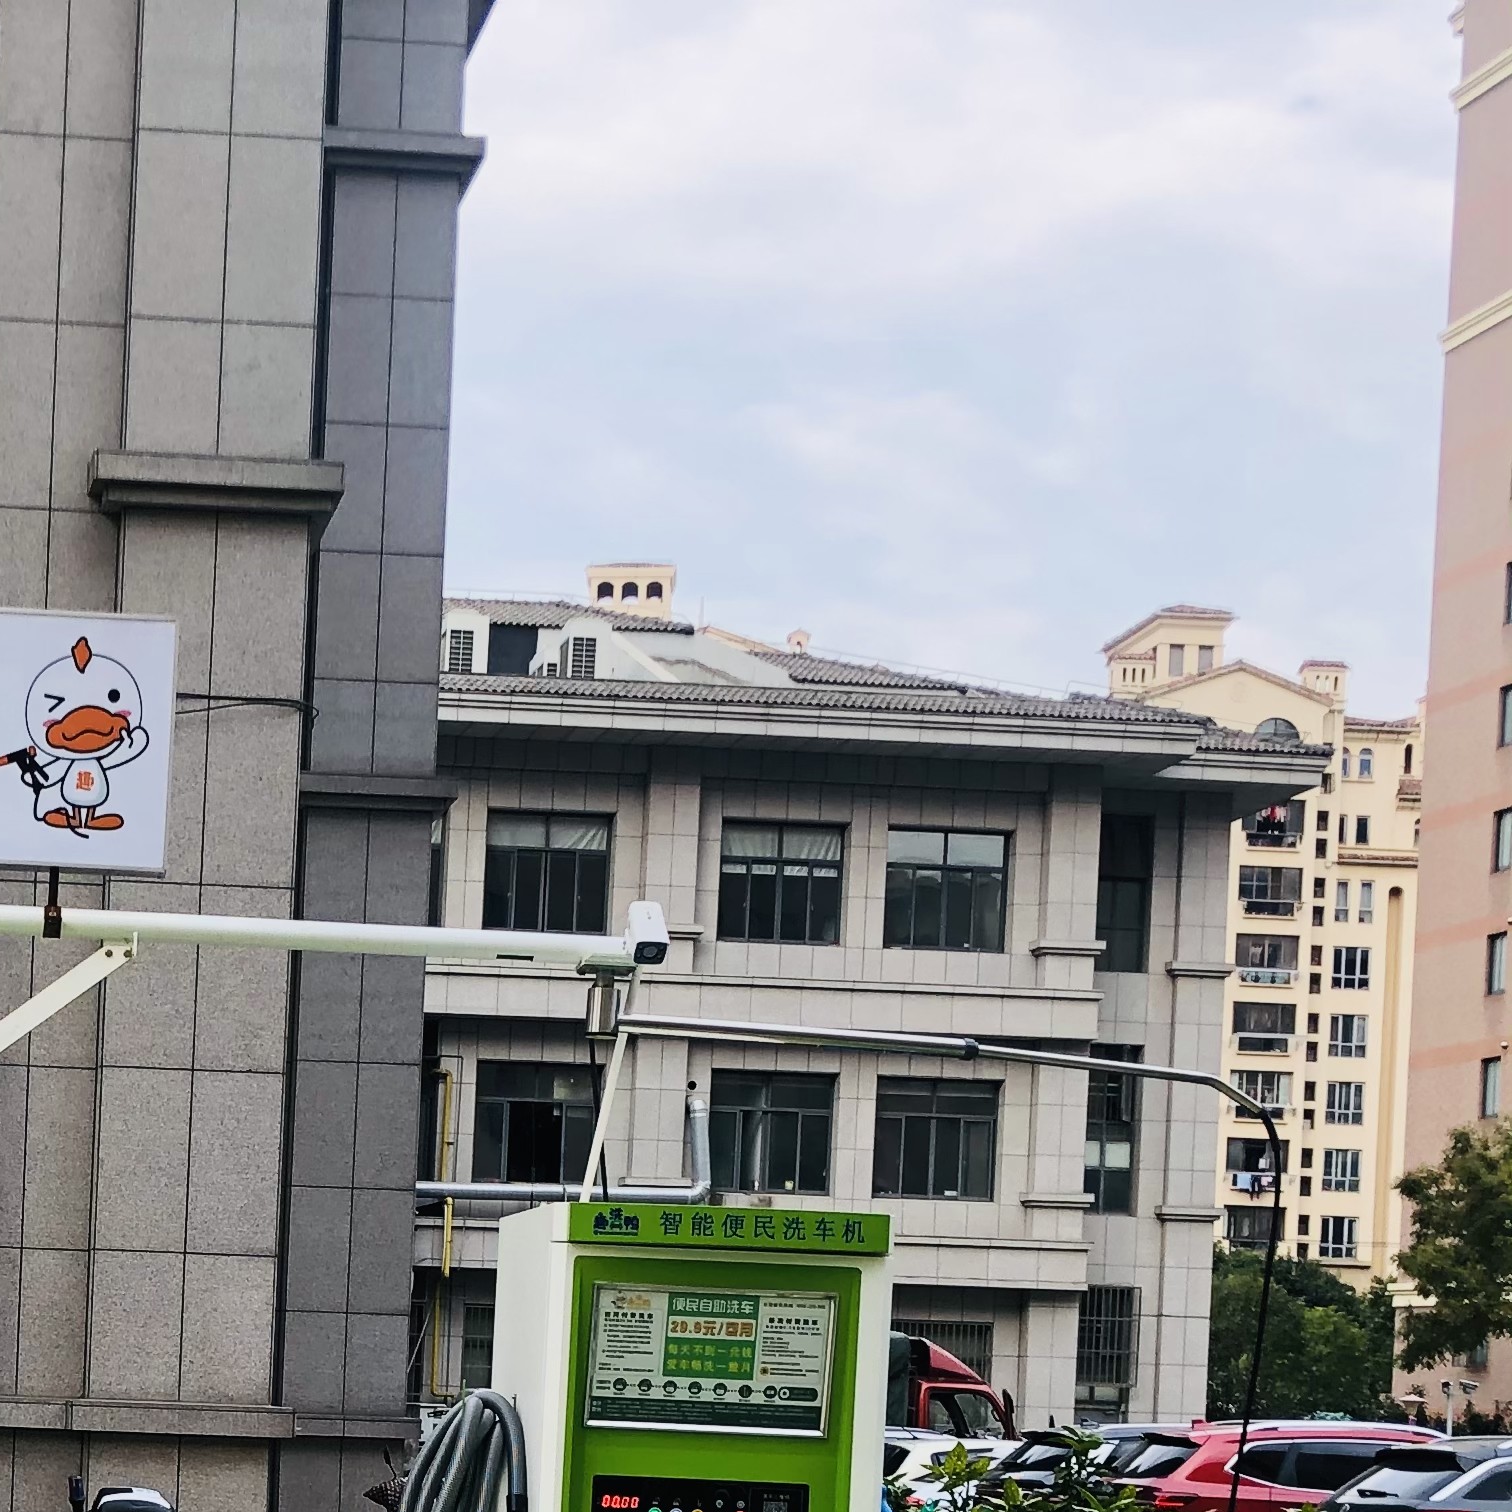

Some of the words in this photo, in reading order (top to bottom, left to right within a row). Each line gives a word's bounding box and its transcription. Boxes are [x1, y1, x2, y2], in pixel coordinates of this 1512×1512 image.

[660, 1211, 866, 1244] 智能便民洗车机
[672, 1297, 754, 1314] 便民自助洗车
